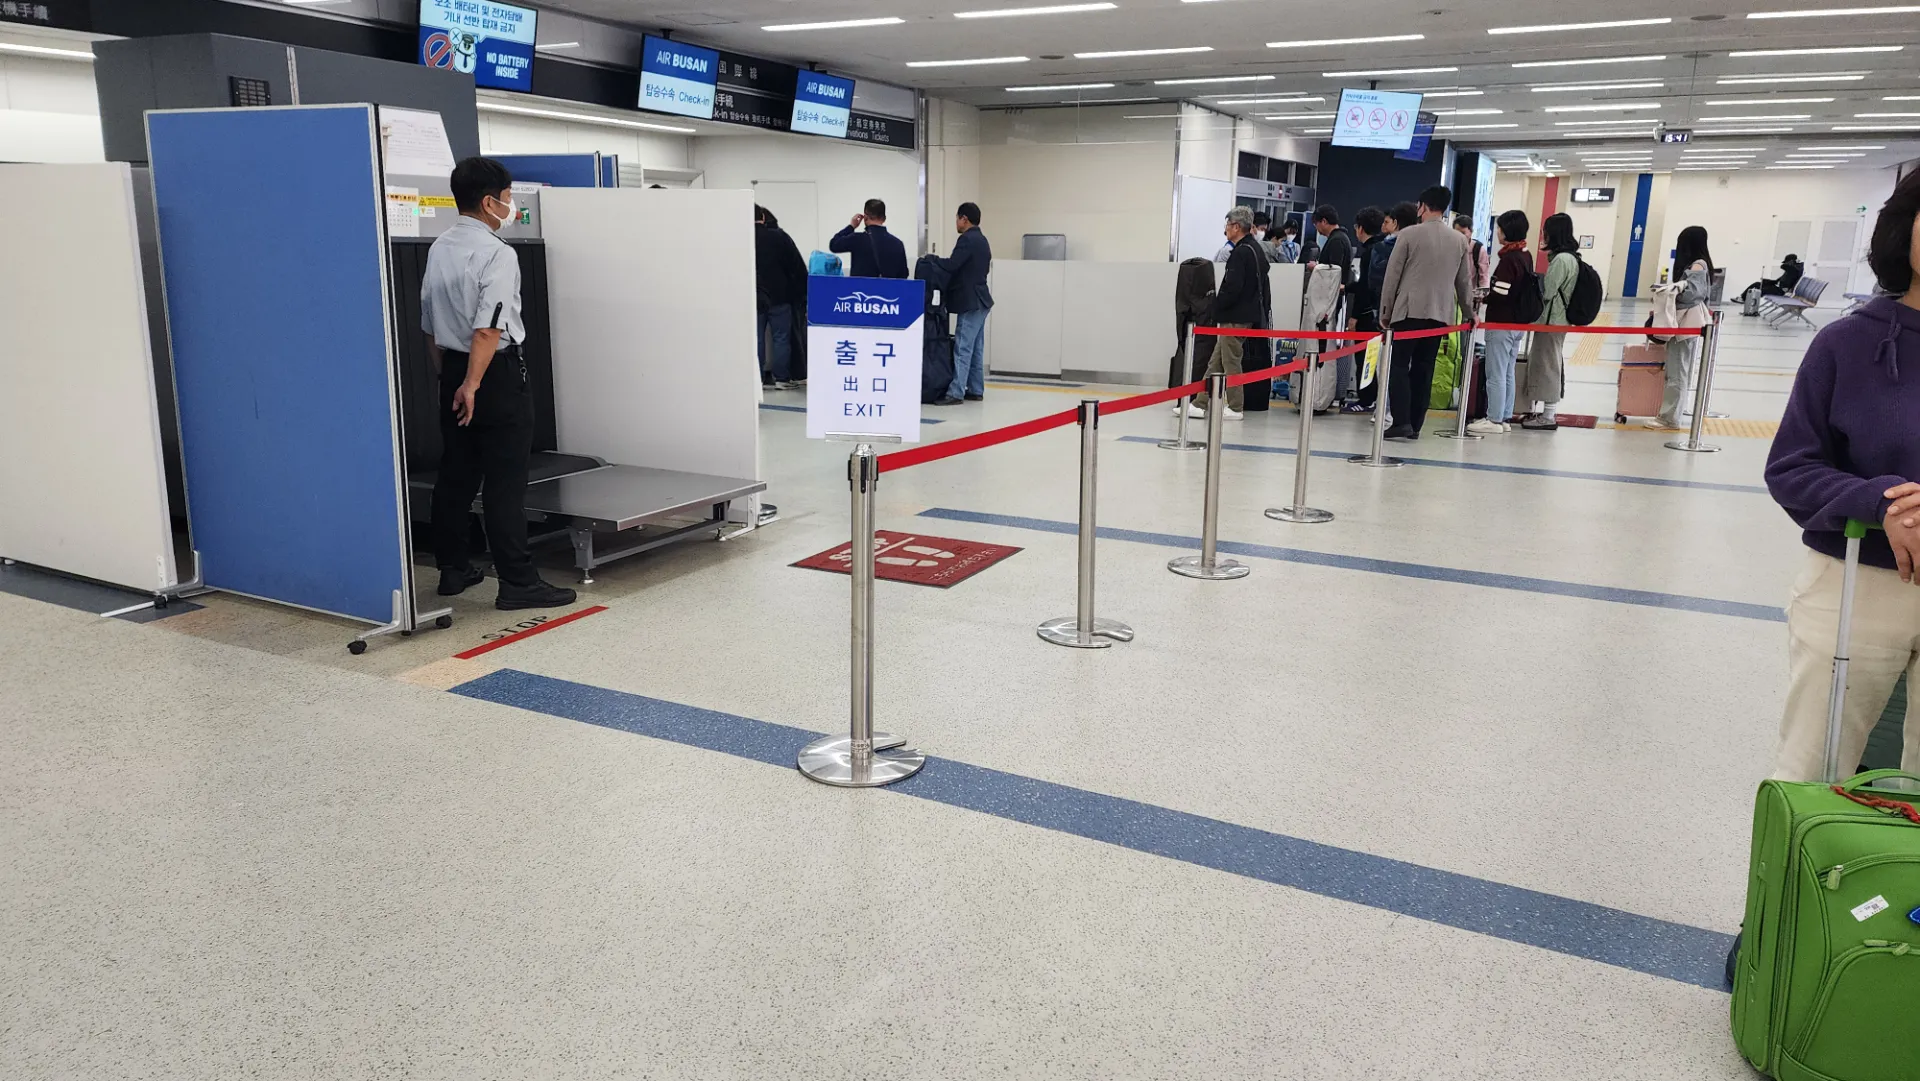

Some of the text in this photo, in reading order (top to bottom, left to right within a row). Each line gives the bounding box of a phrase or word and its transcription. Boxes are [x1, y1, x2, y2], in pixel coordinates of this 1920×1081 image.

[444, 10, 516, 33] 기내 선반 탑재 금지
[482, 6, 490, 16] 및
[493, 8, 523, 22] 전자담배
[487, 51, 530, 68] NO BATTERY
[656, 50, 708, 72] AIR BUSAN
[496, 65, 519, 79] INSIDE
[646, 83, 710, 106] 탑승수속 Check-in
[806, 81, 846, 99] AIR BUSAN
[797, 109, 845, 127] 탑승수속 Check-in
[871, 130, 890, 142] Tickets
[833, 301, 900, 316] AIR BUSAN
[834, 339, 896, 368] 출구
[843, 375, 887, 393] 出口
[844, 402, 886, 417] EXIT
[481, 615, 548, 640] STOP
